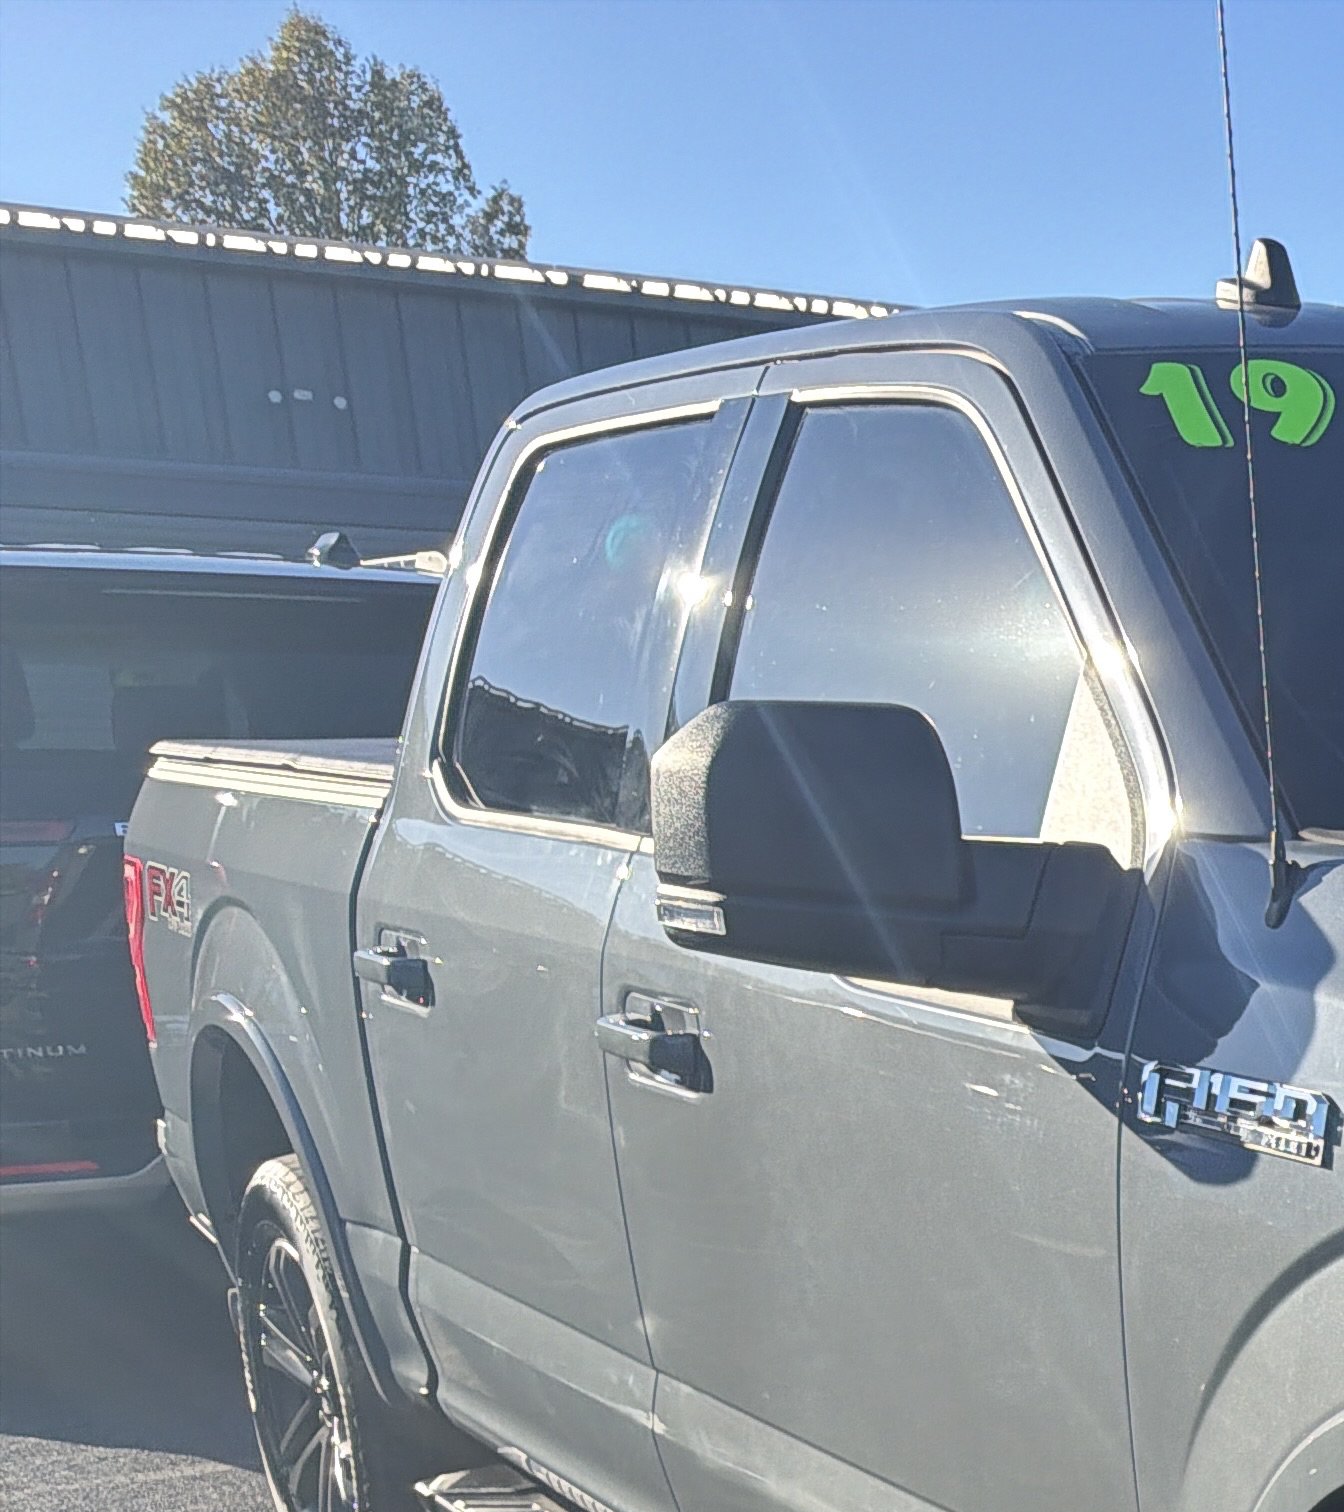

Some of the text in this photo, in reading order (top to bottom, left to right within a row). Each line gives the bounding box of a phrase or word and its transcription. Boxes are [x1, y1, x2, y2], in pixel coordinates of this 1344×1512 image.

[1139, 359, 1336, 448] 19
[145, 861, 191, 922] FX4
[0, 1043, 86, 1060] TINUM
